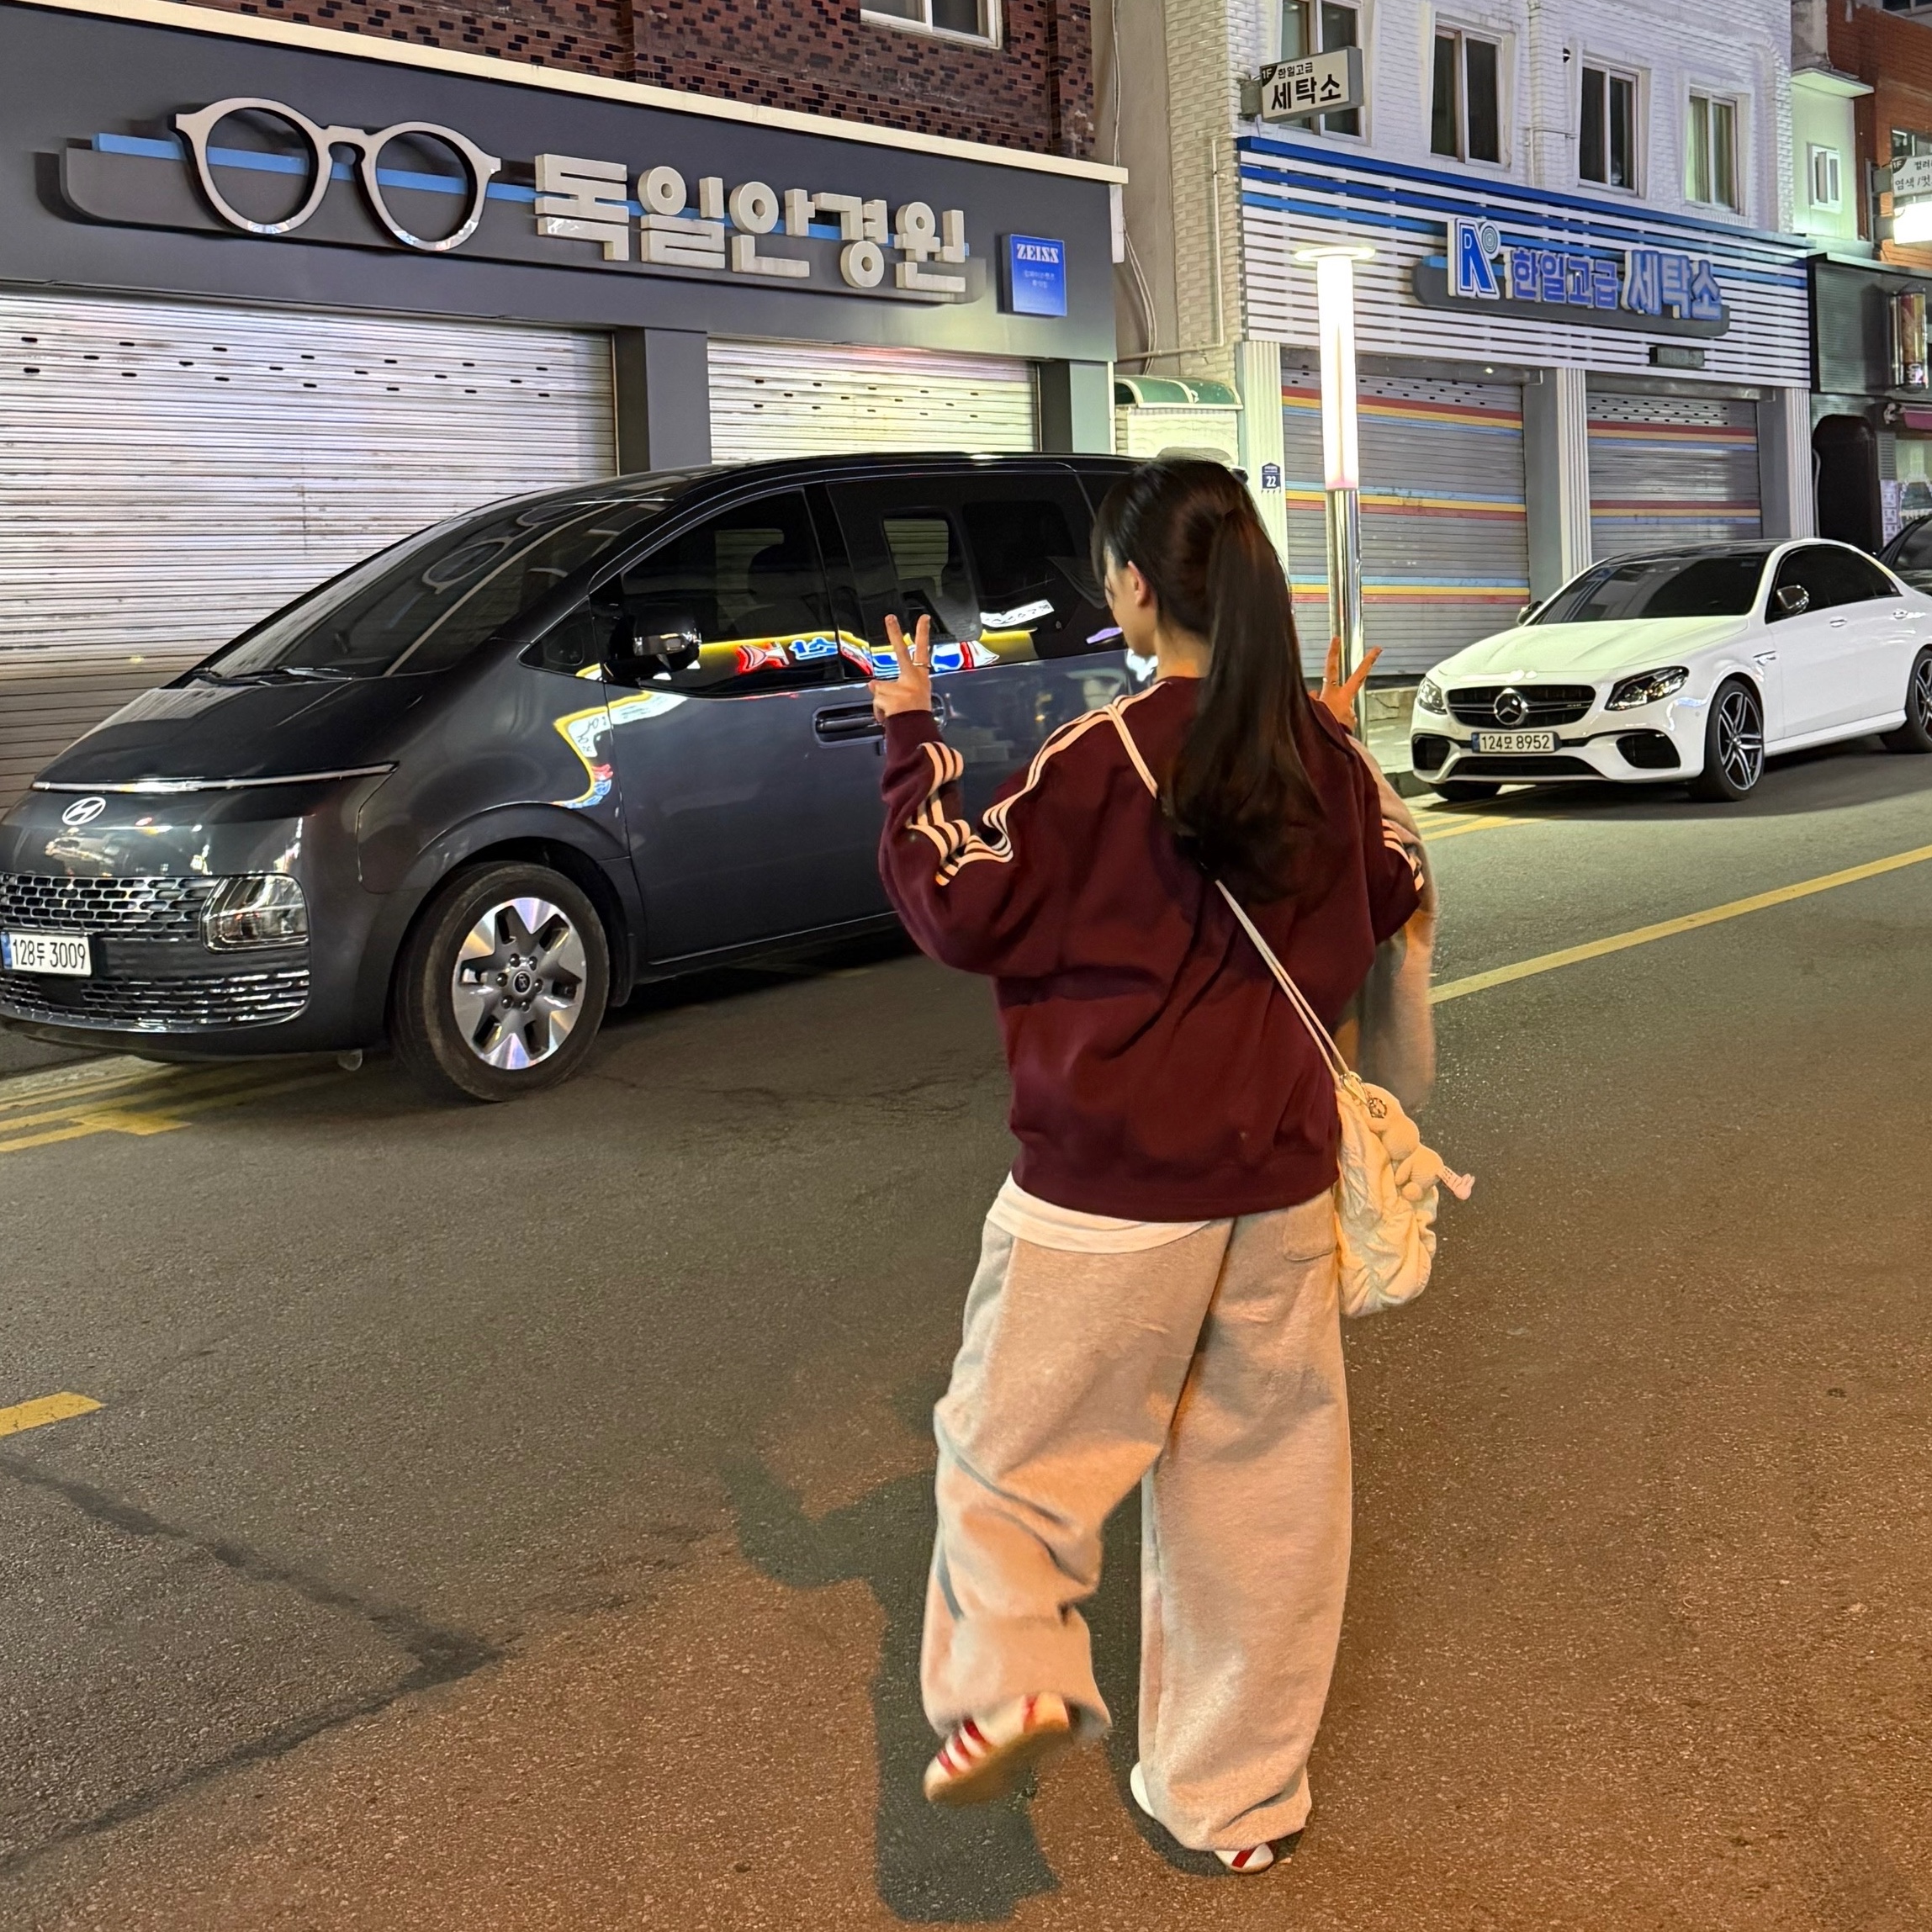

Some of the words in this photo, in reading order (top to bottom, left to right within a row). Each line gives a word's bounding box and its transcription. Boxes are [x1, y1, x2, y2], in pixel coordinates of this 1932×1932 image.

[1262, 68, 1273, 79] 1F
[1278, 61, 1313, 79] 한일고급
[1271, 73, 1342, 110] 세탁소
[535, 153, 966, 293] 독일안경원
[1016, 243, 1060, 264] ZEISS
[1511, 247, 1618, 310] 한일고급
[1628, 249, 1723, 321] 세탁소
[1266, 475, 1277, 488] 22
[1516, 734, 1550, 749] 8952
[13, 939, 45, 966] 128두
[50, 942, 86, 970] 3009
